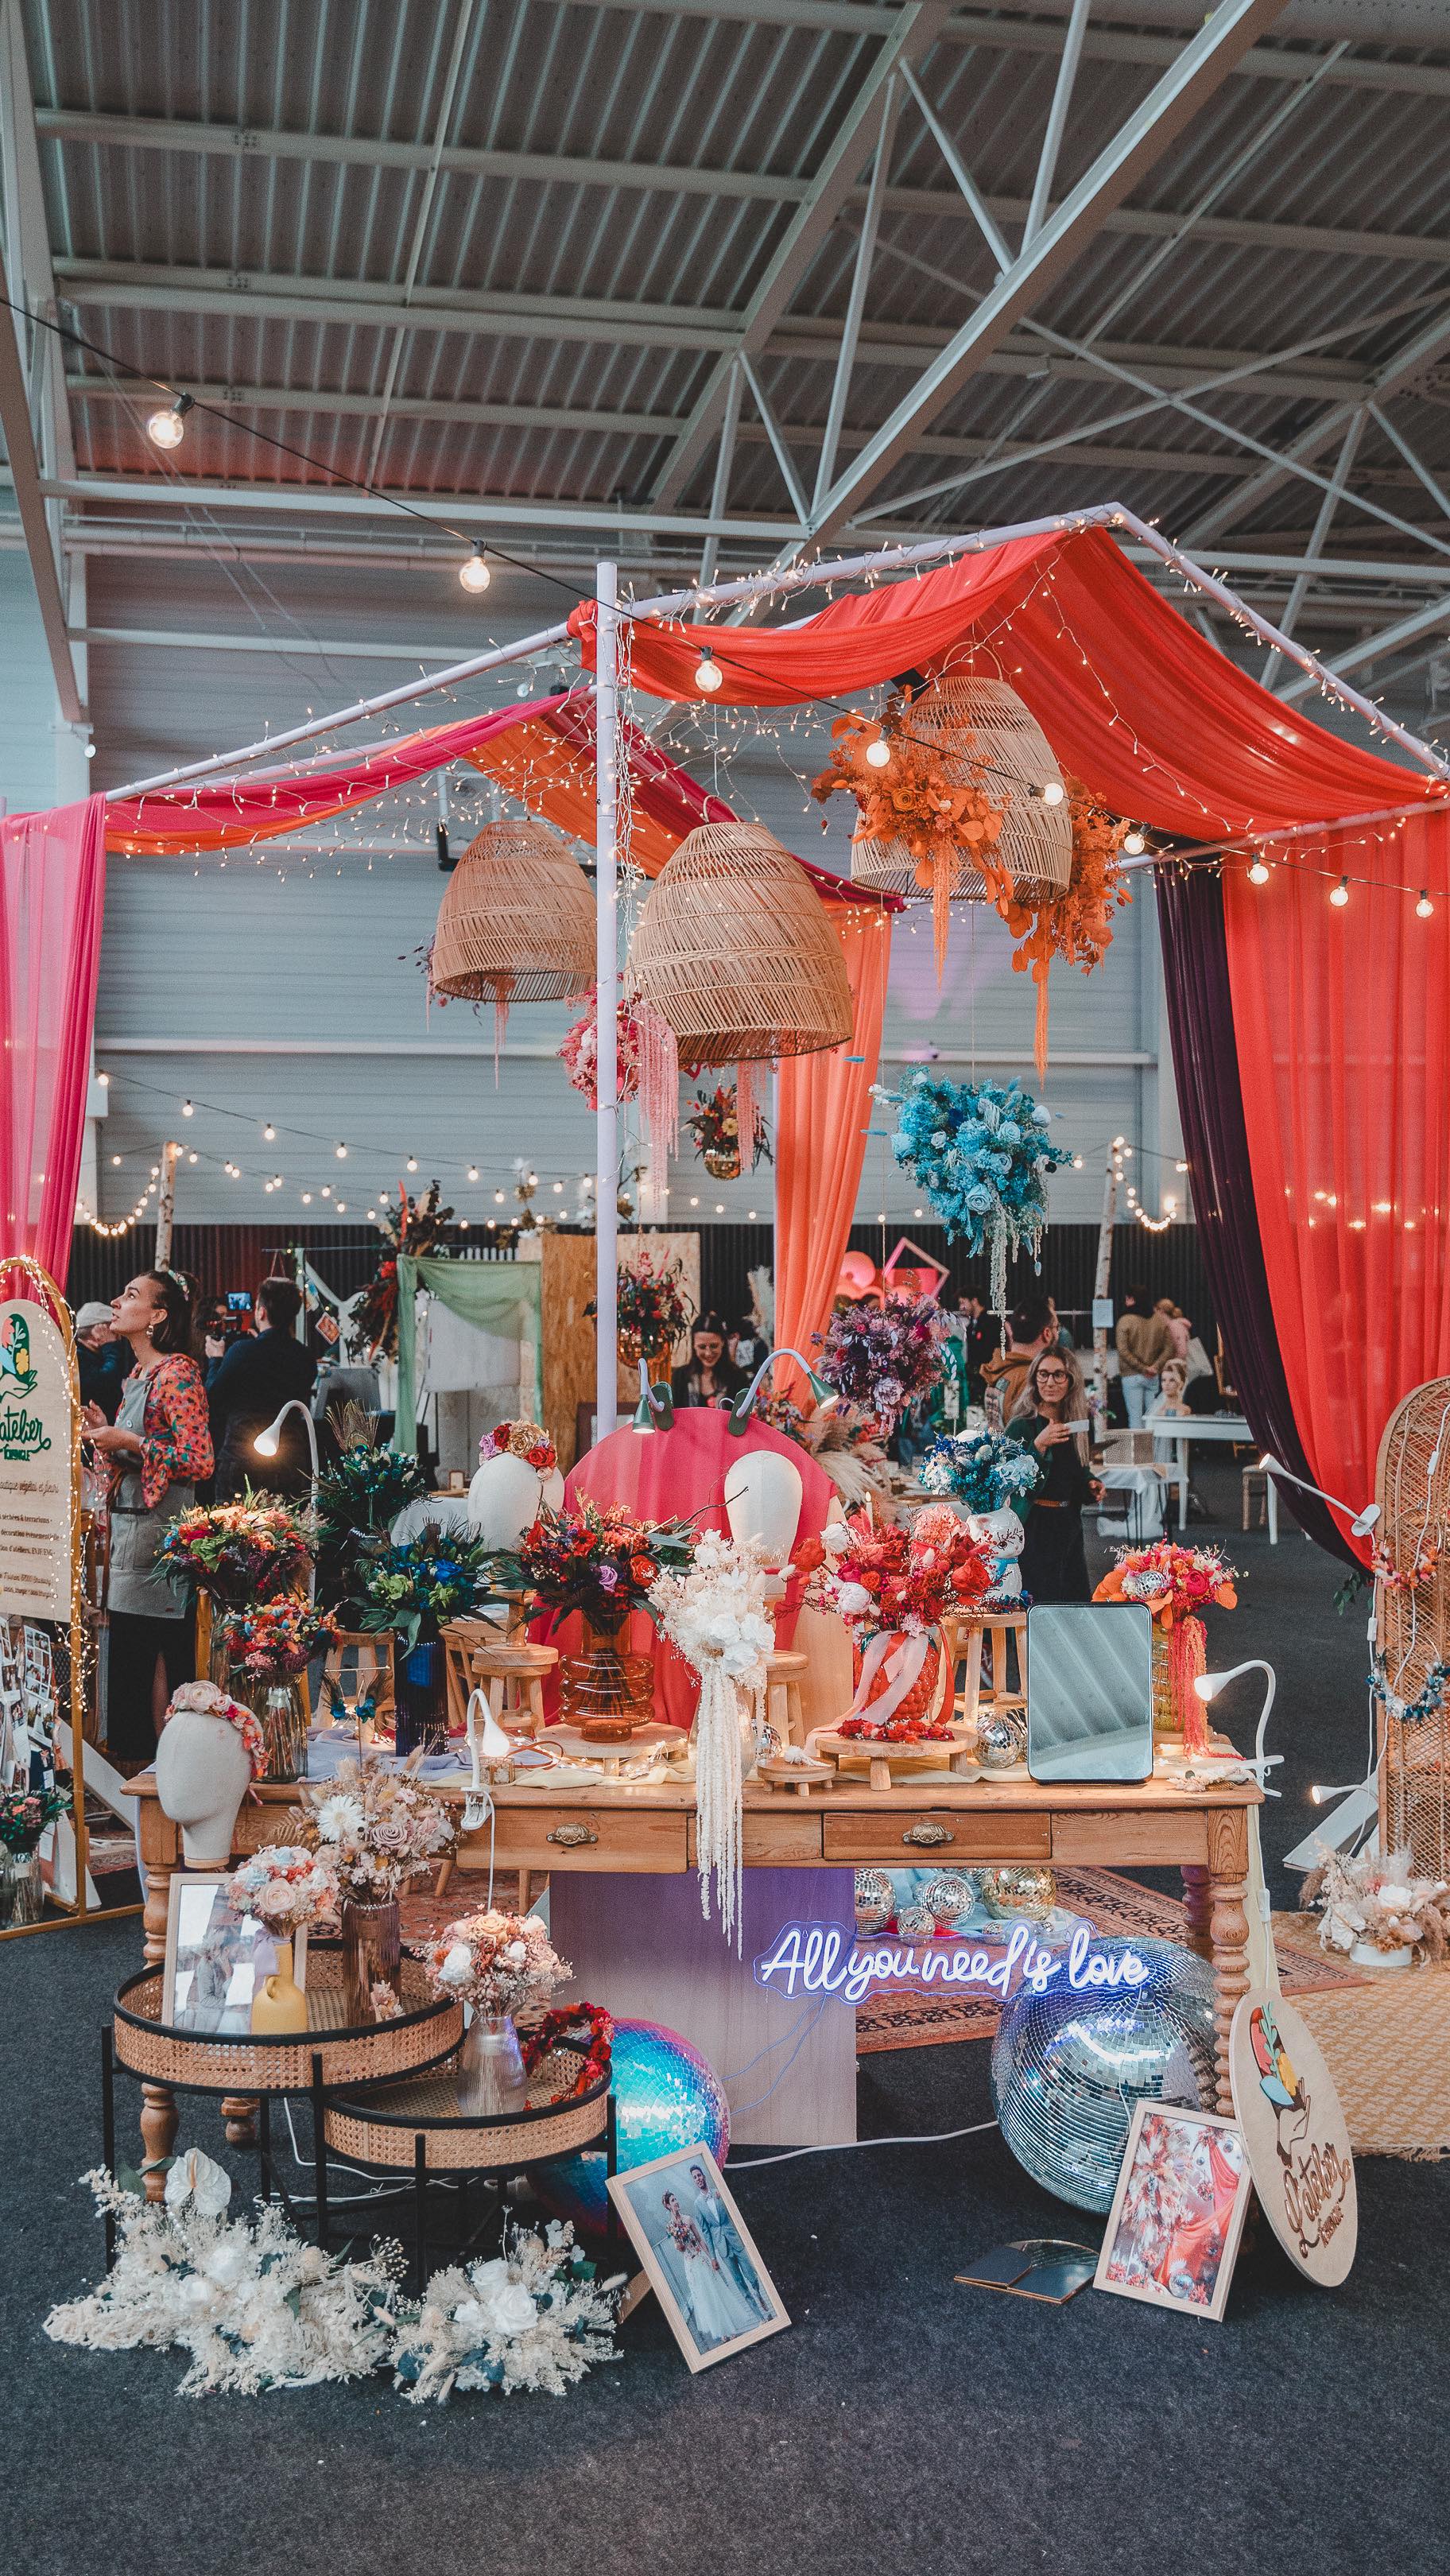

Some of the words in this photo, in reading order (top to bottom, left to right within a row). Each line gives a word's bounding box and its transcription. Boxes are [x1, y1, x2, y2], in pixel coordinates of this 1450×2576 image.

[761, 1930, 848, 1995] All
[844, 1947, 919, 2002] you
[921, 1924, 1030, 1997] need
[1022, 1938, 1063, 1993] is
[1069, 1924, 1150, 1988] love
